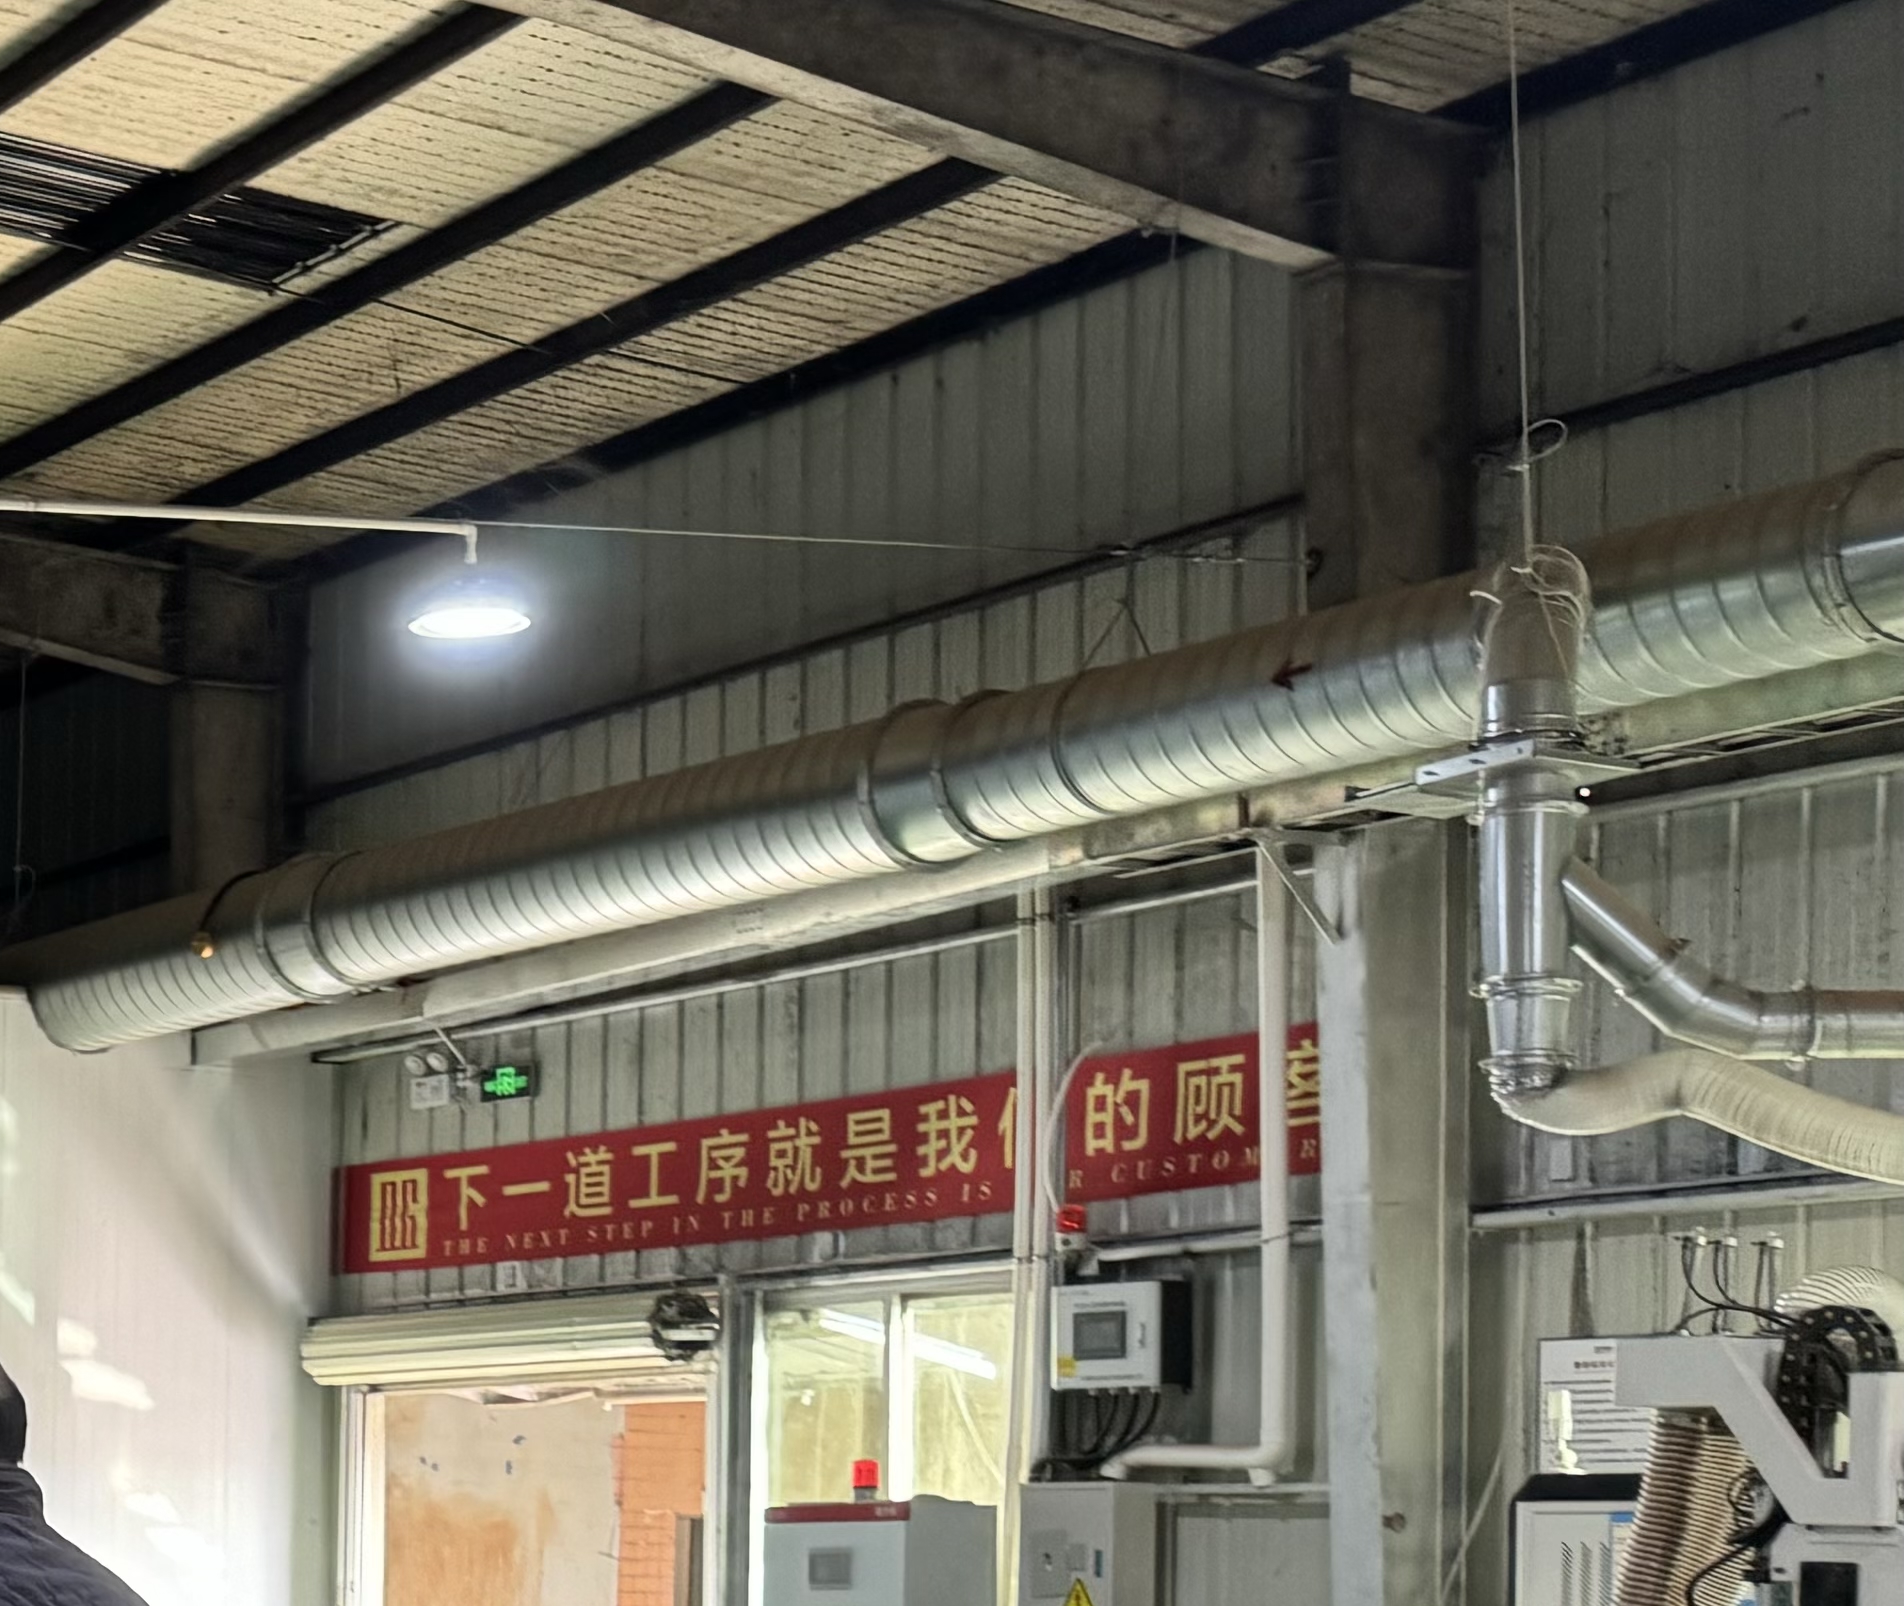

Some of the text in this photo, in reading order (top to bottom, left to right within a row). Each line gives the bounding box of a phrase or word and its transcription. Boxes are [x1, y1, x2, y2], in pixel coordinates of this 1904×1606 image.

[442, 1237, 489, 1256] THE
[505, 1229, 570, 1249] NEXT
[587, 1220, 654, 1243] STEP
[671, 1214, 701, 1234] IN
[721, 1207, 776, 1230] THE
[796, 1187, 939, 1222] PROCESS
[961, 1180, 992, 1203] IS
[1110, 1138, 1318, 1184] CUSTOMR
